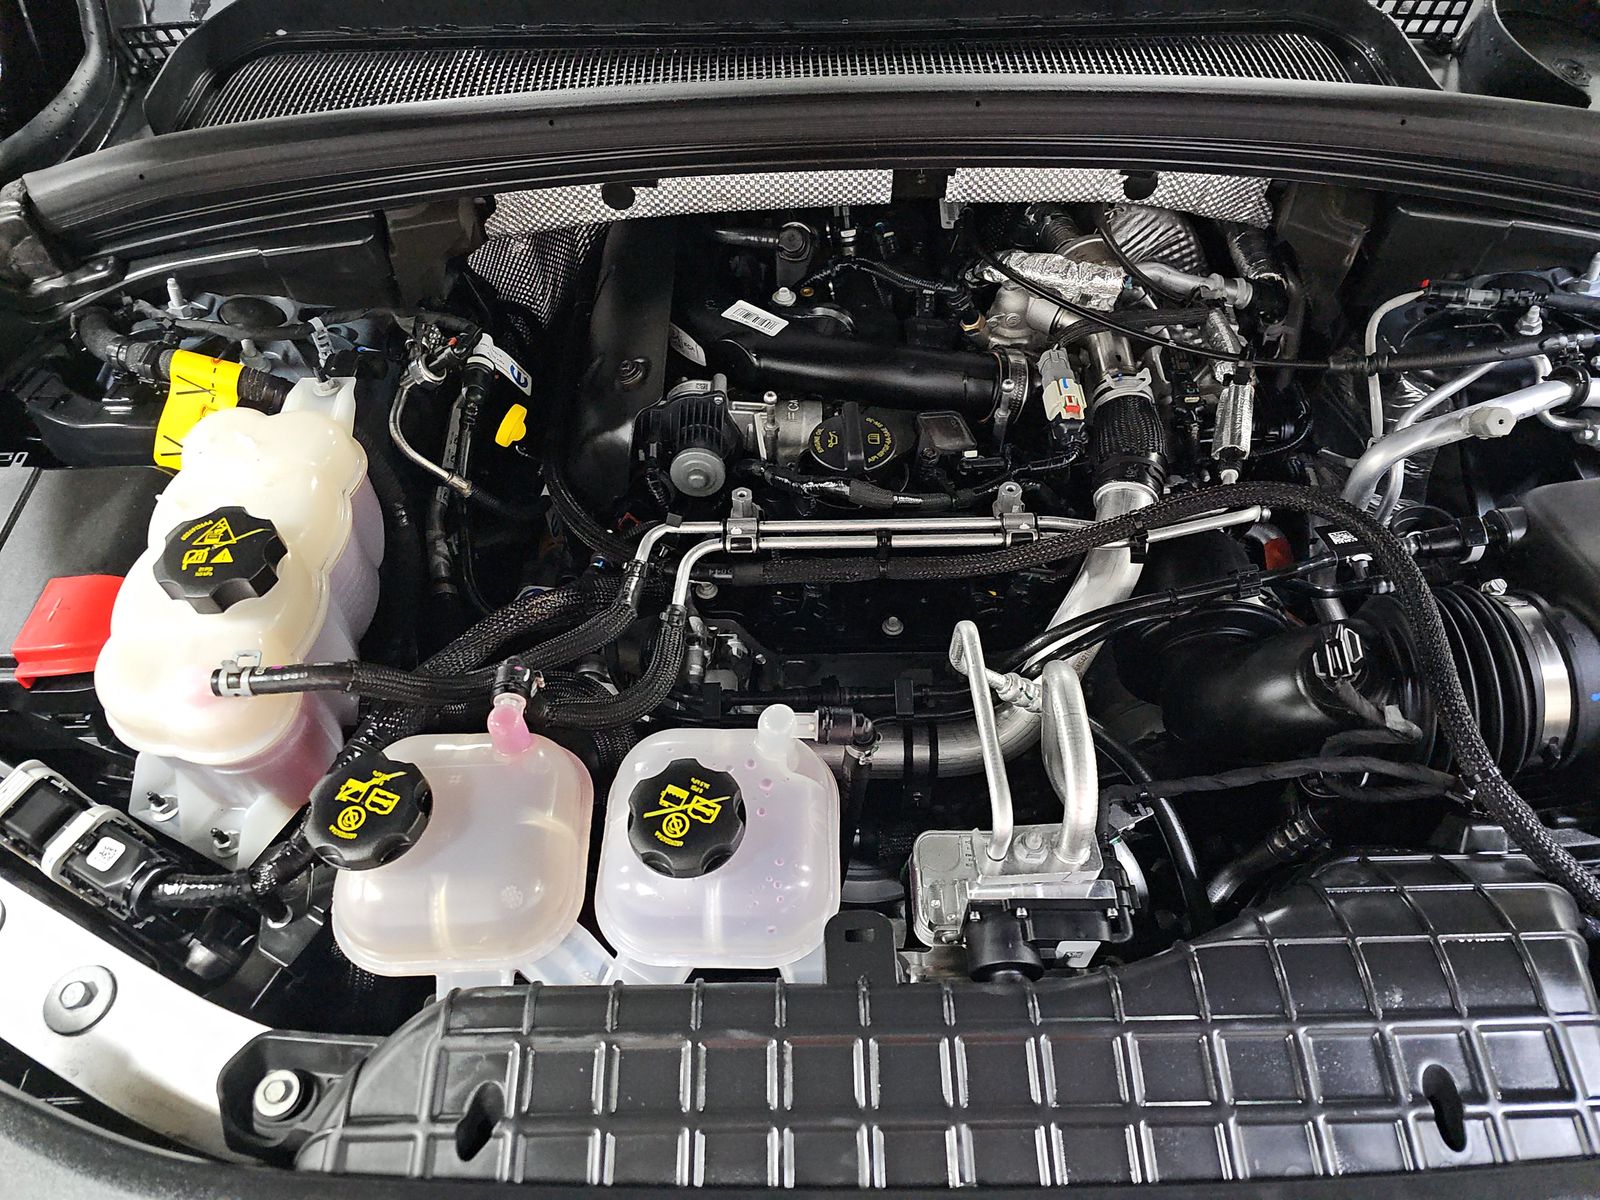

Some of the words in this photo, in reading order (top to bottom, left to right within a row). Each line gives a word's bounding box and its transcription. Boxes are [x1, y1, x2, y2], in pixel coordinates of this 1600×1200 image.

[815, 428, 825, 436] OIL
[814, 436, 825, 453] ENGINE
[867, 455, 879, 463] API
